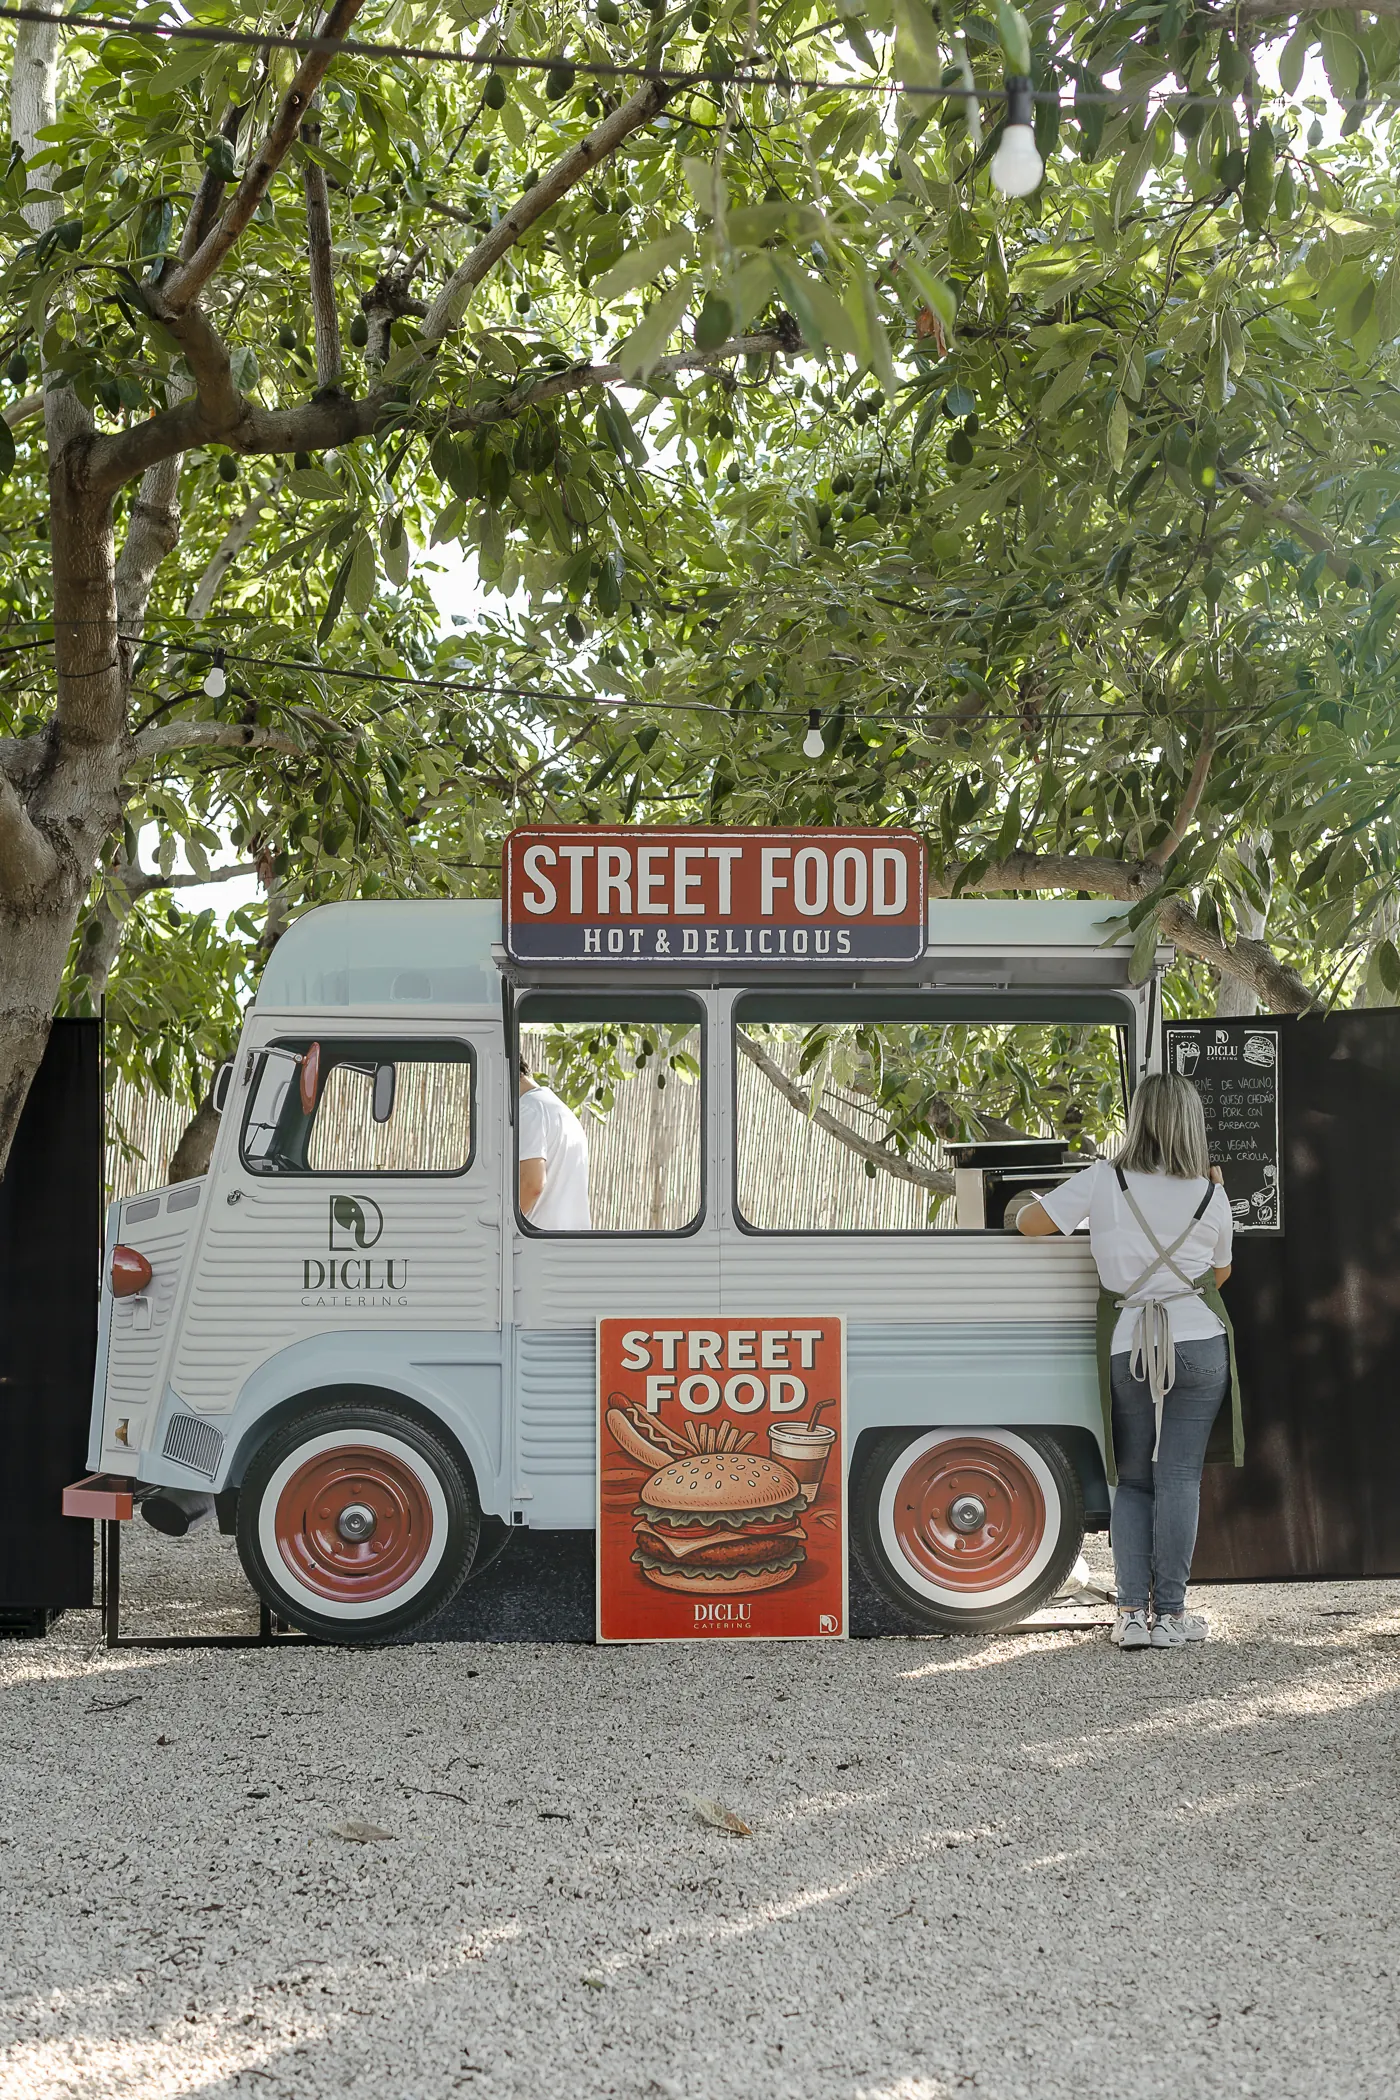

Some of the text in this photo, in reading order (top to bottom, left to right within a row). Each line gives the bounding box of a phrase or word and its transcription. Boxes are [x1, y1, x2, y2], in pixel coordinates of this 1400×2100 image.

[522, 845, 909, 917] STREET FOOD
[583, 928, 852, 955] HOT & DELICIOUS
[1206, 1045, 1238, 1056] DICLU
[1194, 1076, 1274, 1091] RNE DE VACUNO,
[1200, 1094, 1214, 1105] SO
[1219, 1094, 1244, 1106] QUESO
[1204, 1105, 1263, 1118] ED PORK CON
[1205, 1123, 1213, 1132] A
[1208, 1136, 1258, 1151] ER VEGANA
[1209, 1153, 1232, 1163] BOLLA
[301, 1258, 411, 1290] DICLU
[300, 1296, 408, 1307] CATERING
[620, 1329, 824, 1371] STREET
[646, 1373, 808, 1415] FOOD
[693, 1603, 752, 1621] DICLU
[693, 1622, 752, 1630] CATERING
